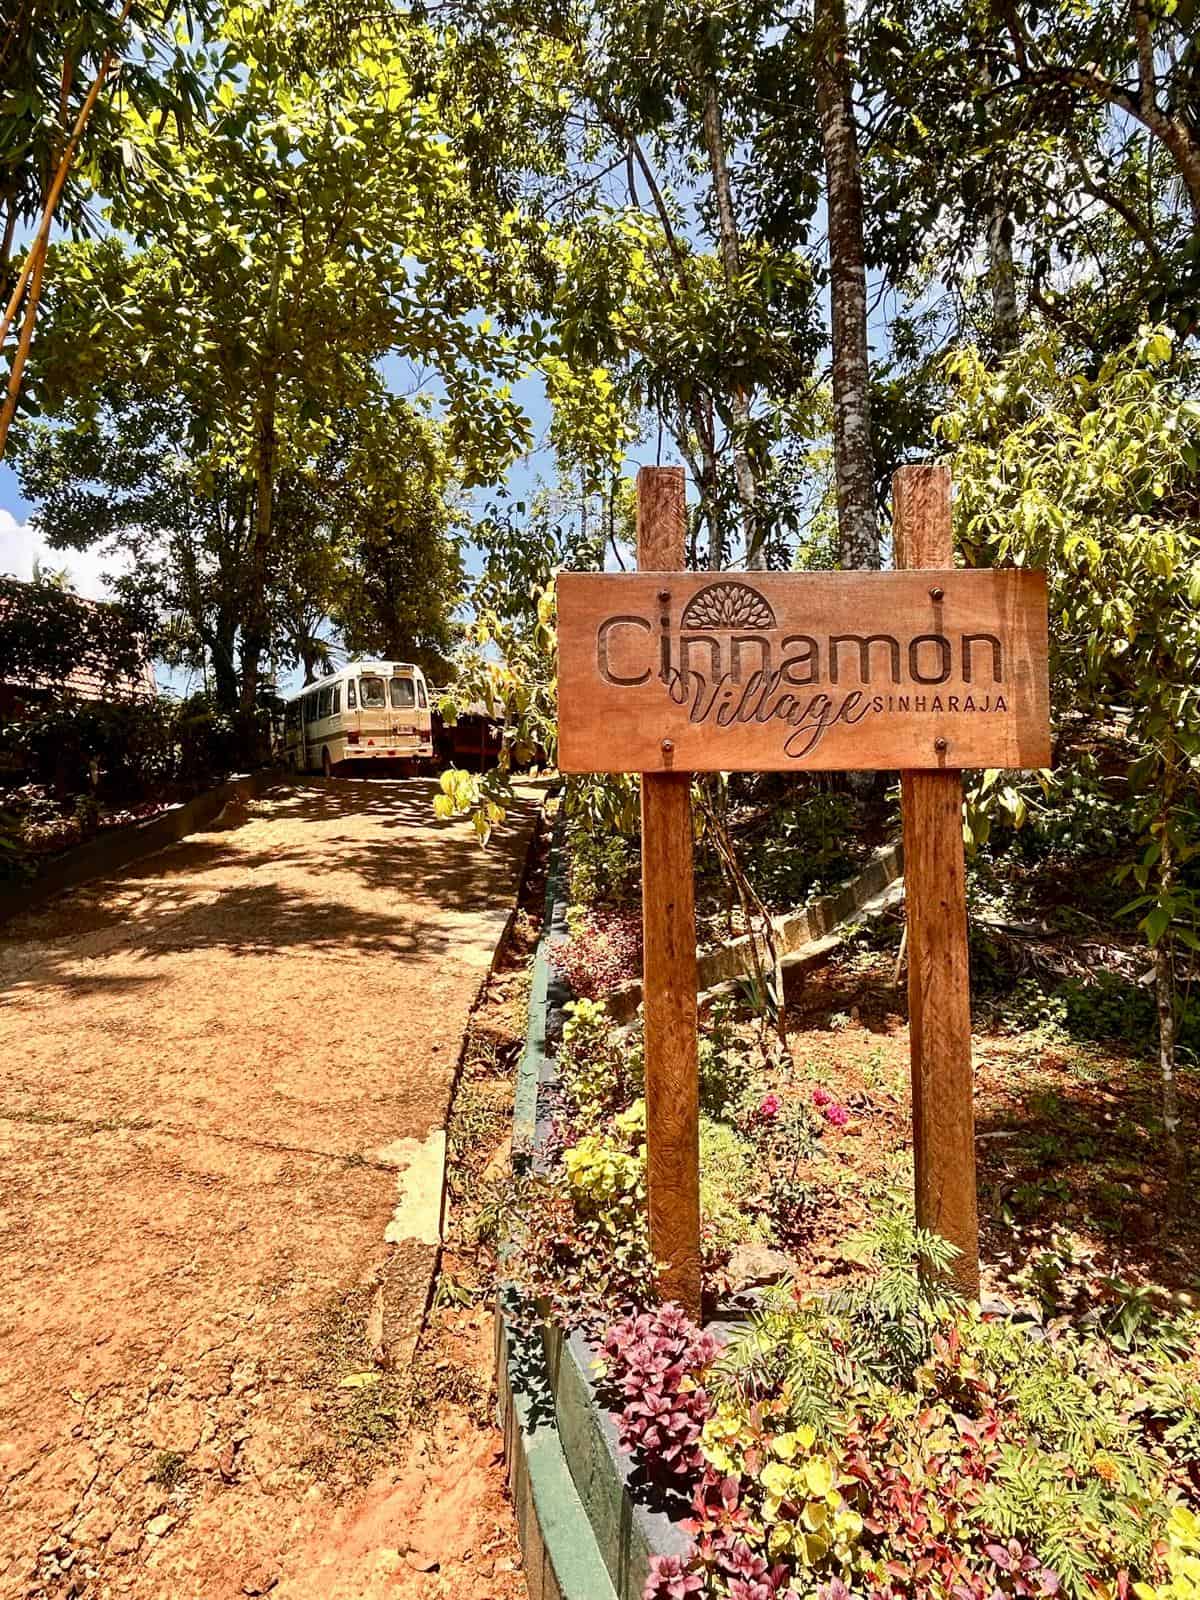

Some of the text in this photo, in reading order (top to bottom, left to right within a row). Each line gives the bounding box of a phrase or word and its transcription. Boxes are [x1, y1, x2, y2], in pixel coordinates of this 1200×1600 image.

[597, 615, 1002, 686] Cinnamon
[668, 667, 1008, 758] Village SINHARAJA
